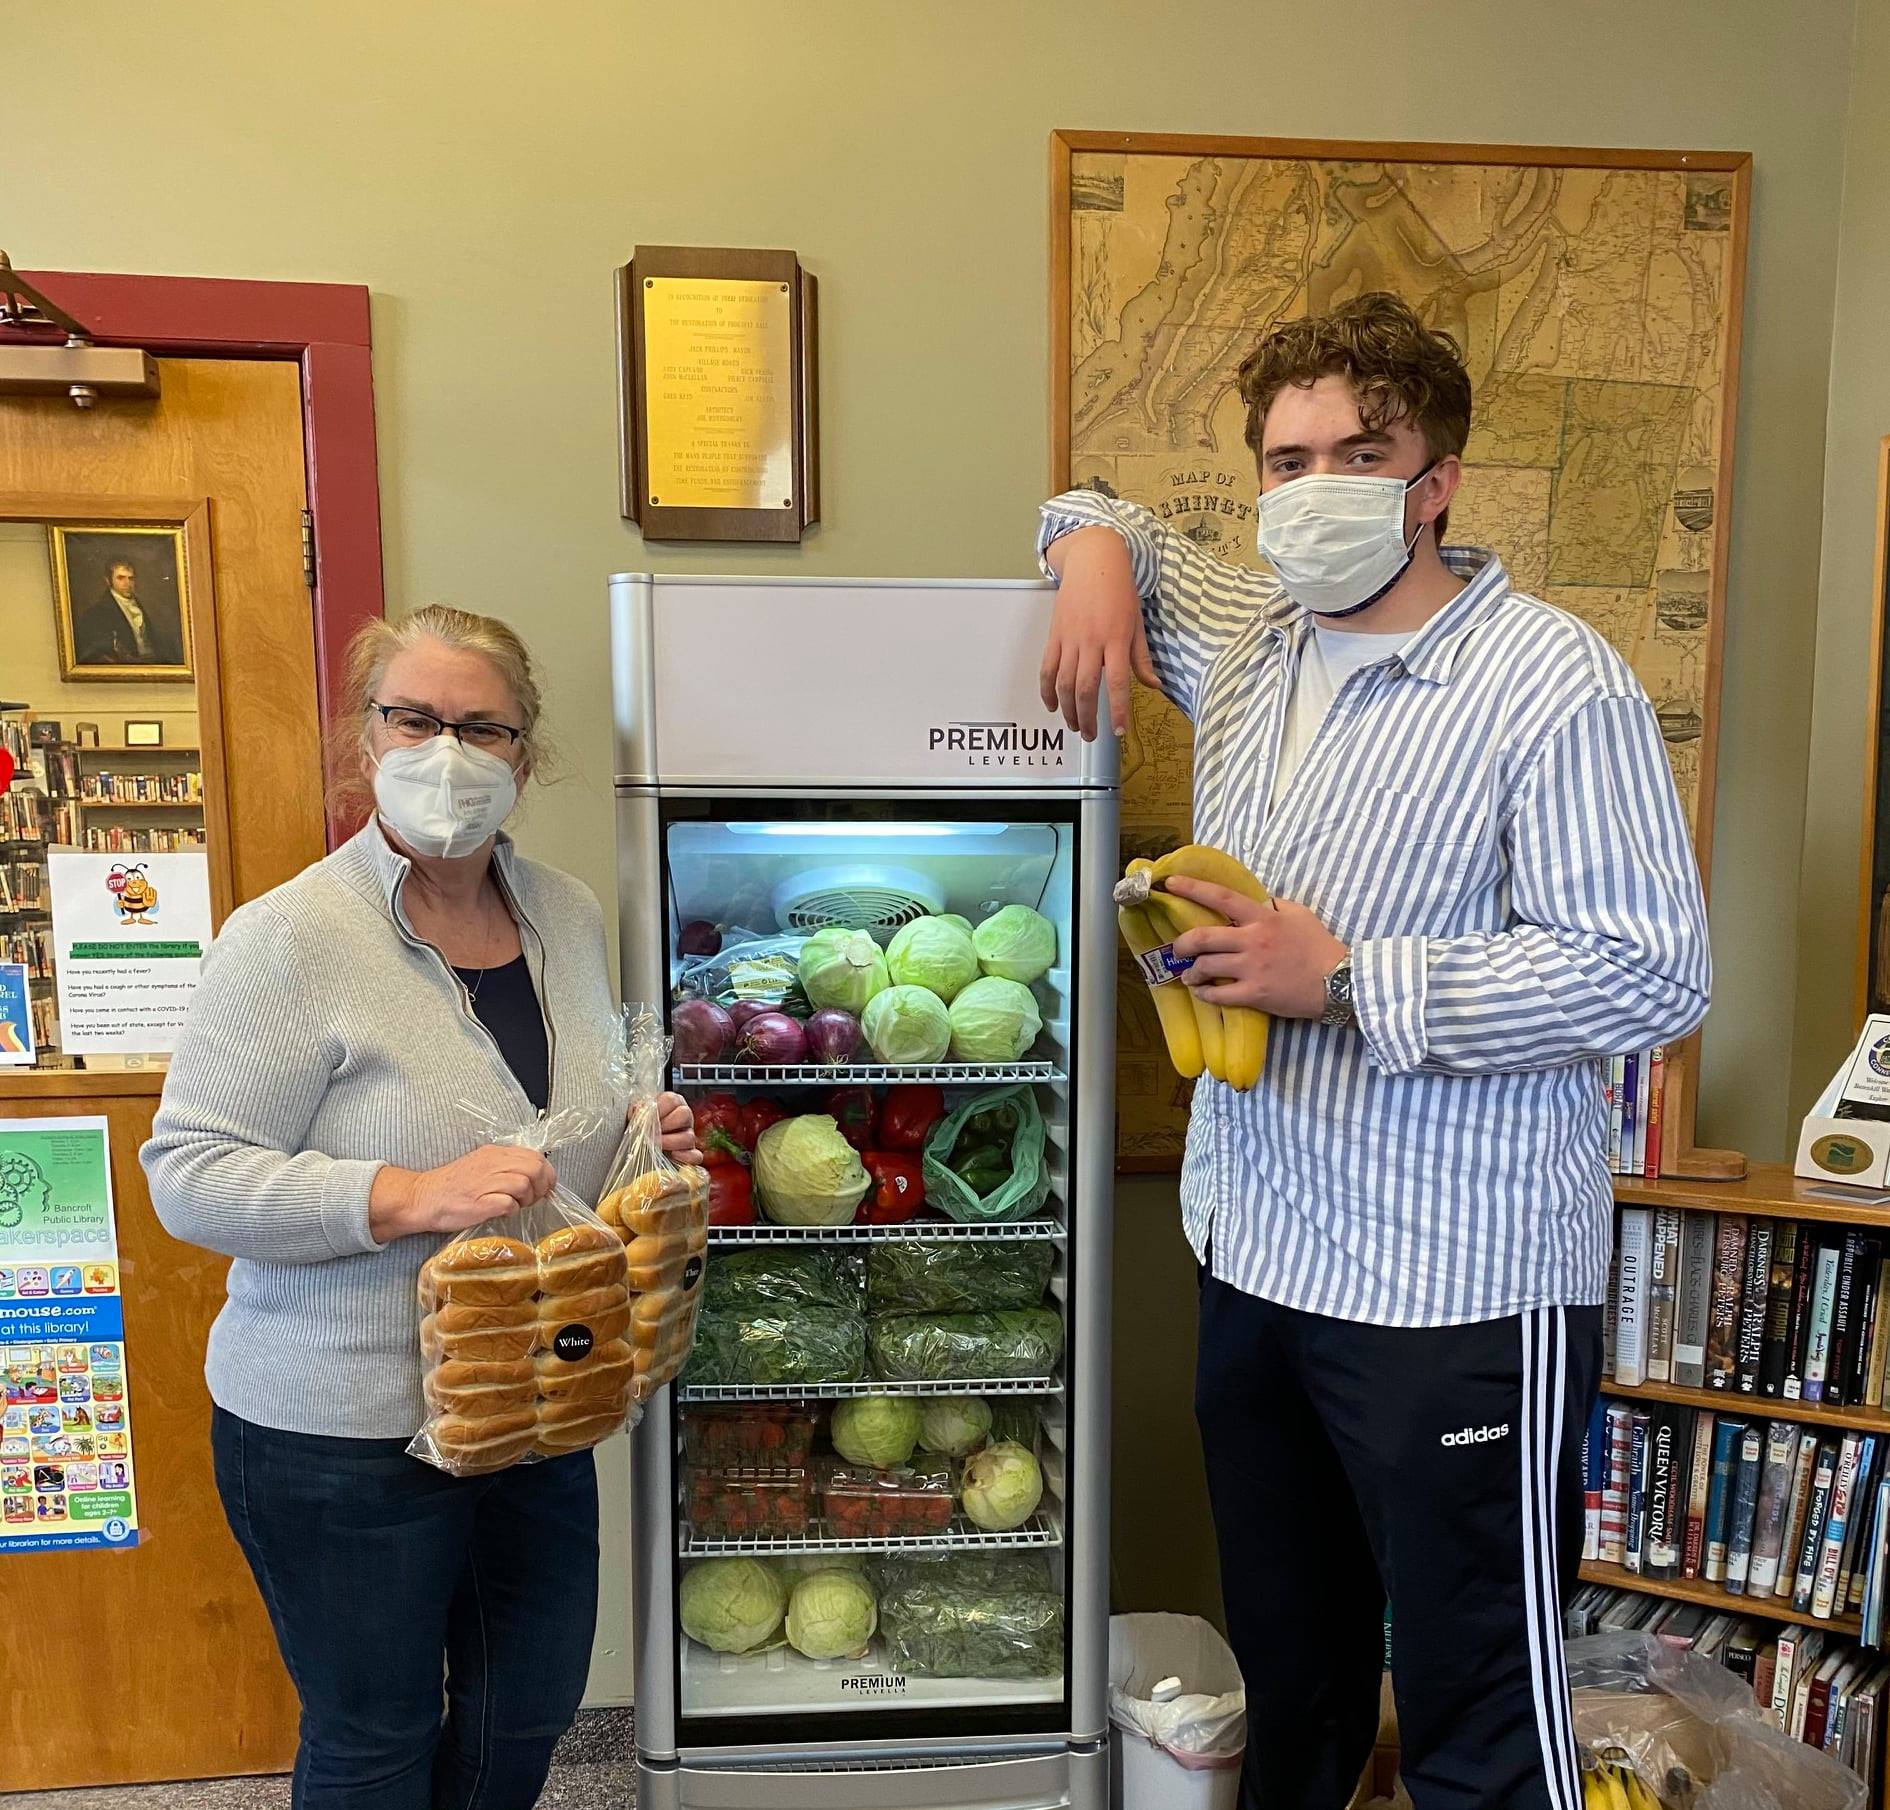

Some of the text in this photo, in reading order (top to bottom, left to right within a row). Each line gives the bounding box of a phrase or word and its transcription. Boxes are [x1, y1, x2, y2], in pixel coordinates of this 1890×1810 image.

[1172, 471, 1211, 487] MAP
[929, 726, 1064, 751] PREMIUM
[969, 756, 1064, 766] LEVELLA
[108, 878, 126, 889] STOP
[146, 1021, 166, 1029] except
[43, 1214, 104, 1225] Public Library
[54, 1203, 92, 1213] Bancroft
[1666, 1209, 1679, 1248] WHAT
[1652, 1210, 1668, 1280] HAPPENED
[1728, 1227, 1740, 1273] DAMNED
[1745, 1224, 1757, 1298] CHANCELLORSVILLE
[1753, 1230, 1770, 1288] DARKNESS
[1844, 1238, 1856, 1275] REPUBLIC
[1689, 1256, 1705, 1288] FLAGS
[1840, 1275, 1851, 1299] UNDER
[1620, 1255, 1637, 1325] OUTRAGE
[1715, 1283, 1726, 1328] PETERS
[1723, 1286, 1735, 1327] RALPH
[1766, 1302, 1789, 1343] EMPIRE
[1820, 1303, 1831, 1326] Cried
[1836, 1300, 1849, 1333] ASSAULT
[1, 1320, 89, 1335] at this library!
[558, 1336, 590, 1348] White
[1740, 1307, 1752, 1364] PETERS
[1750, 1312, 1763, 1362] RALPH
[1441, 1424, 1509, 1446] adidas
[1694, 1451, 1702, 1467] LOVE
[1699, 1456, 1708, 1484] POWER
[1839, 1452, 1852, 1490] O'REILLY
[1628, 1426, 1643, 1549] Galbraith Name-Dropping
[1649, 1425, 1672, 1545] QUEEN VICTORIA
[8, 1539, 39, 1547] librarian
[74, 1536, 101, 1544] details.
[1803, 1488, 1824, 1567] FORGED BY FIRE
[1825, 1547, 1839, 1564] BILL
[841, 1674, 906, 1690] PREMIUM
